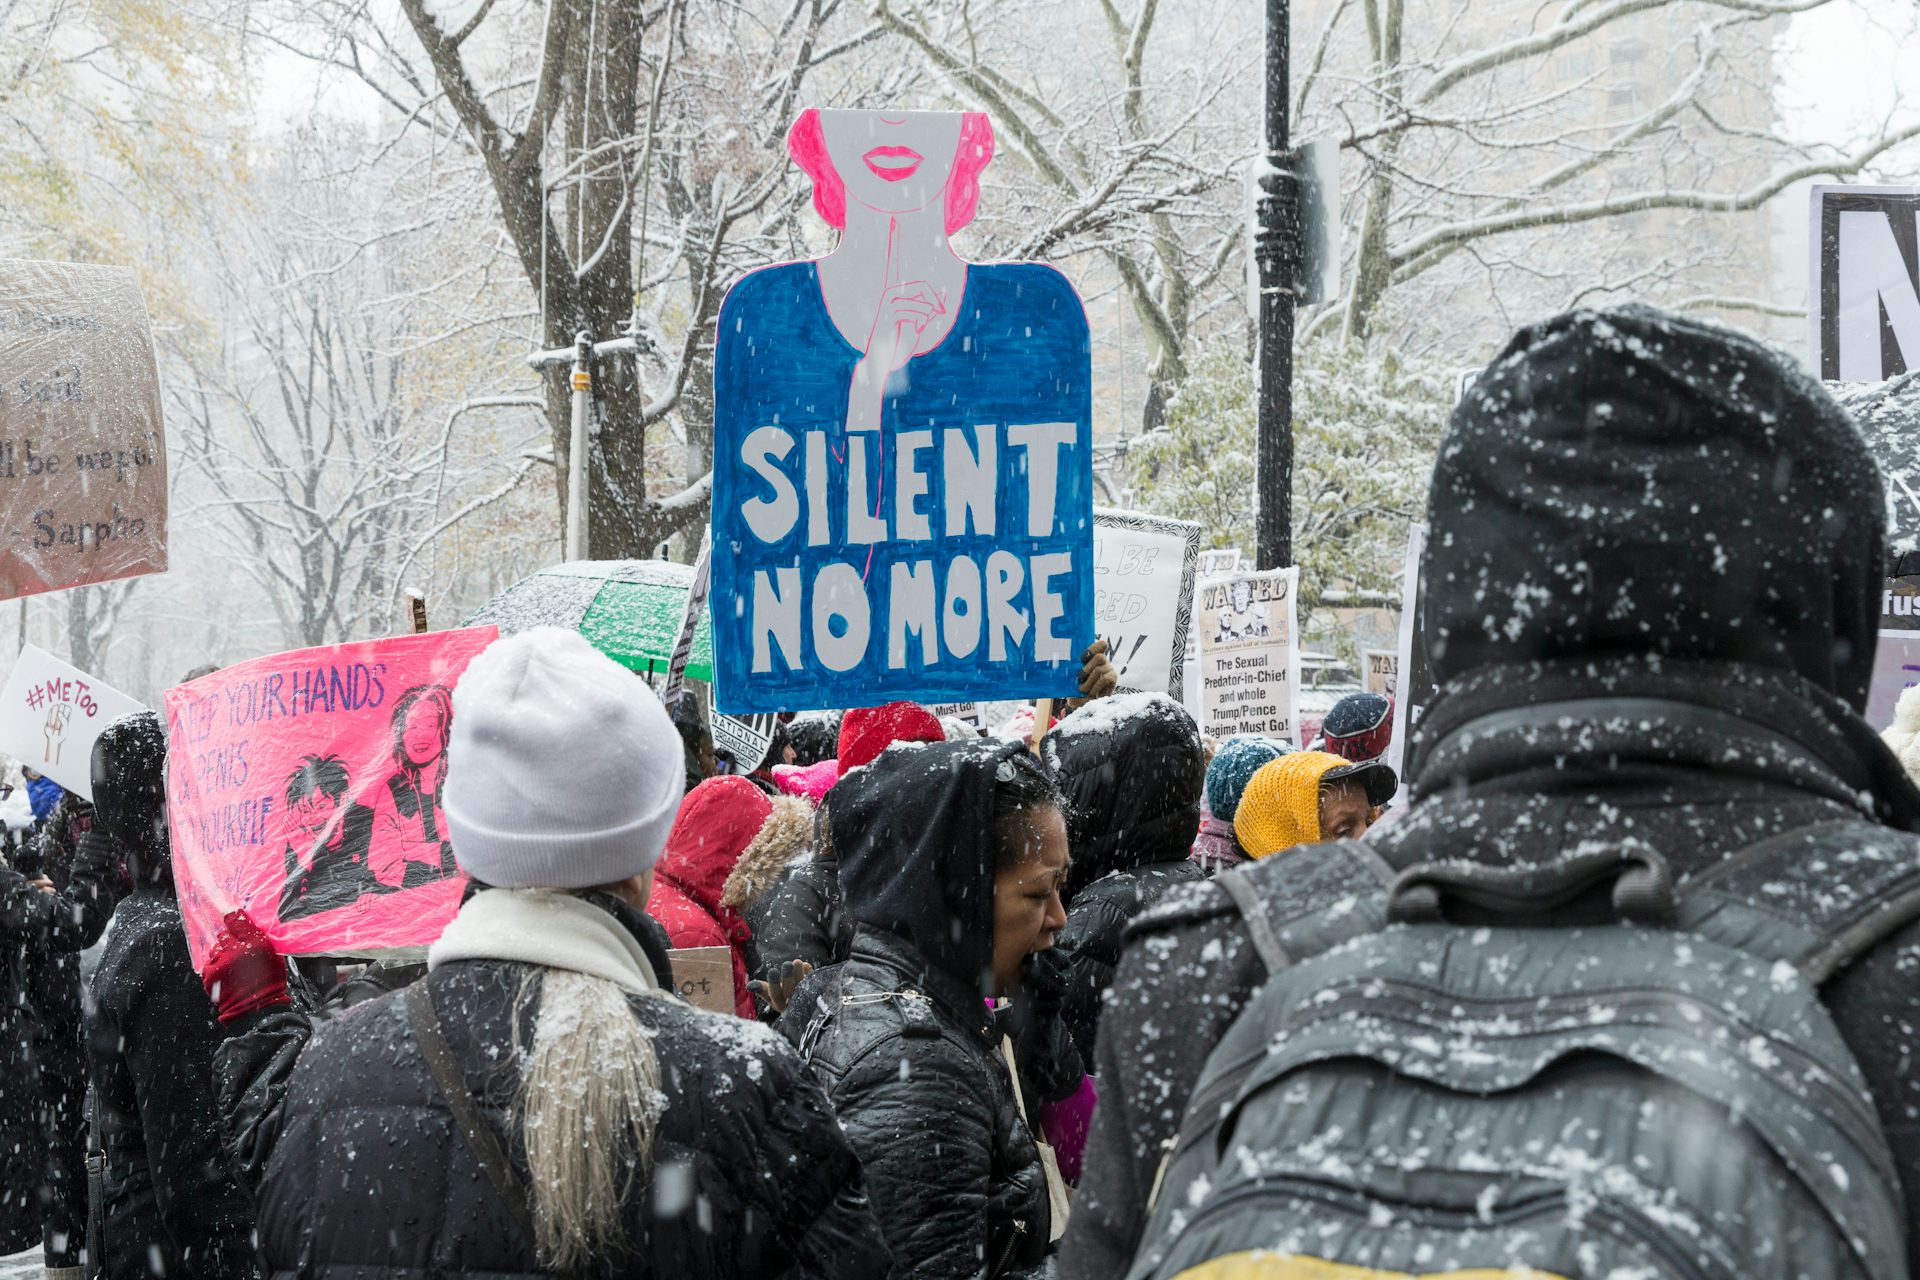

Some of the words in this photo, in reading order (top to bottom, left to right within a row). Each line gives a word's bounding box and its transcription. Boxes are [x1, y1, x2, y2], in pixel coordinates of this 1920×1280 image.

[24, 438, 60, 475] be
[741, 423, 1077, 546] SILENT
[33, 502, 146, 553] Sappho
[1117, 544, 1160, 575] BE
[1204, 577, 1289, 610] WATED
[752, 562, 871, 673] NO
[888, 550, 1072, 670] MORE
[1205, 668, 1287, 689] Predator-in-Chief
[1216, 659, 1233, 671] The
[1235, 654, 1268, 669] Sexual
[226, 673, 287, 726] YOUR
[292, 663, 387, 717] HANDS
[935, 703, 957, 717] Must
[1219, 690, 1235, 703] and
[1237, 687, 1266, 701] whole
[1204, 725, 1237, 739] Regime
[1240, 720, 1266, 733] Must
[1269, 718, 1289, 732] Go!
[1212, 705, 1277, 721] Trump/Pence
[712, 714, 765, 751] NATIONAL
[715, 729, 759, 761] ORGANIZATION
[199, 795, 274, 854] YOURSELF
